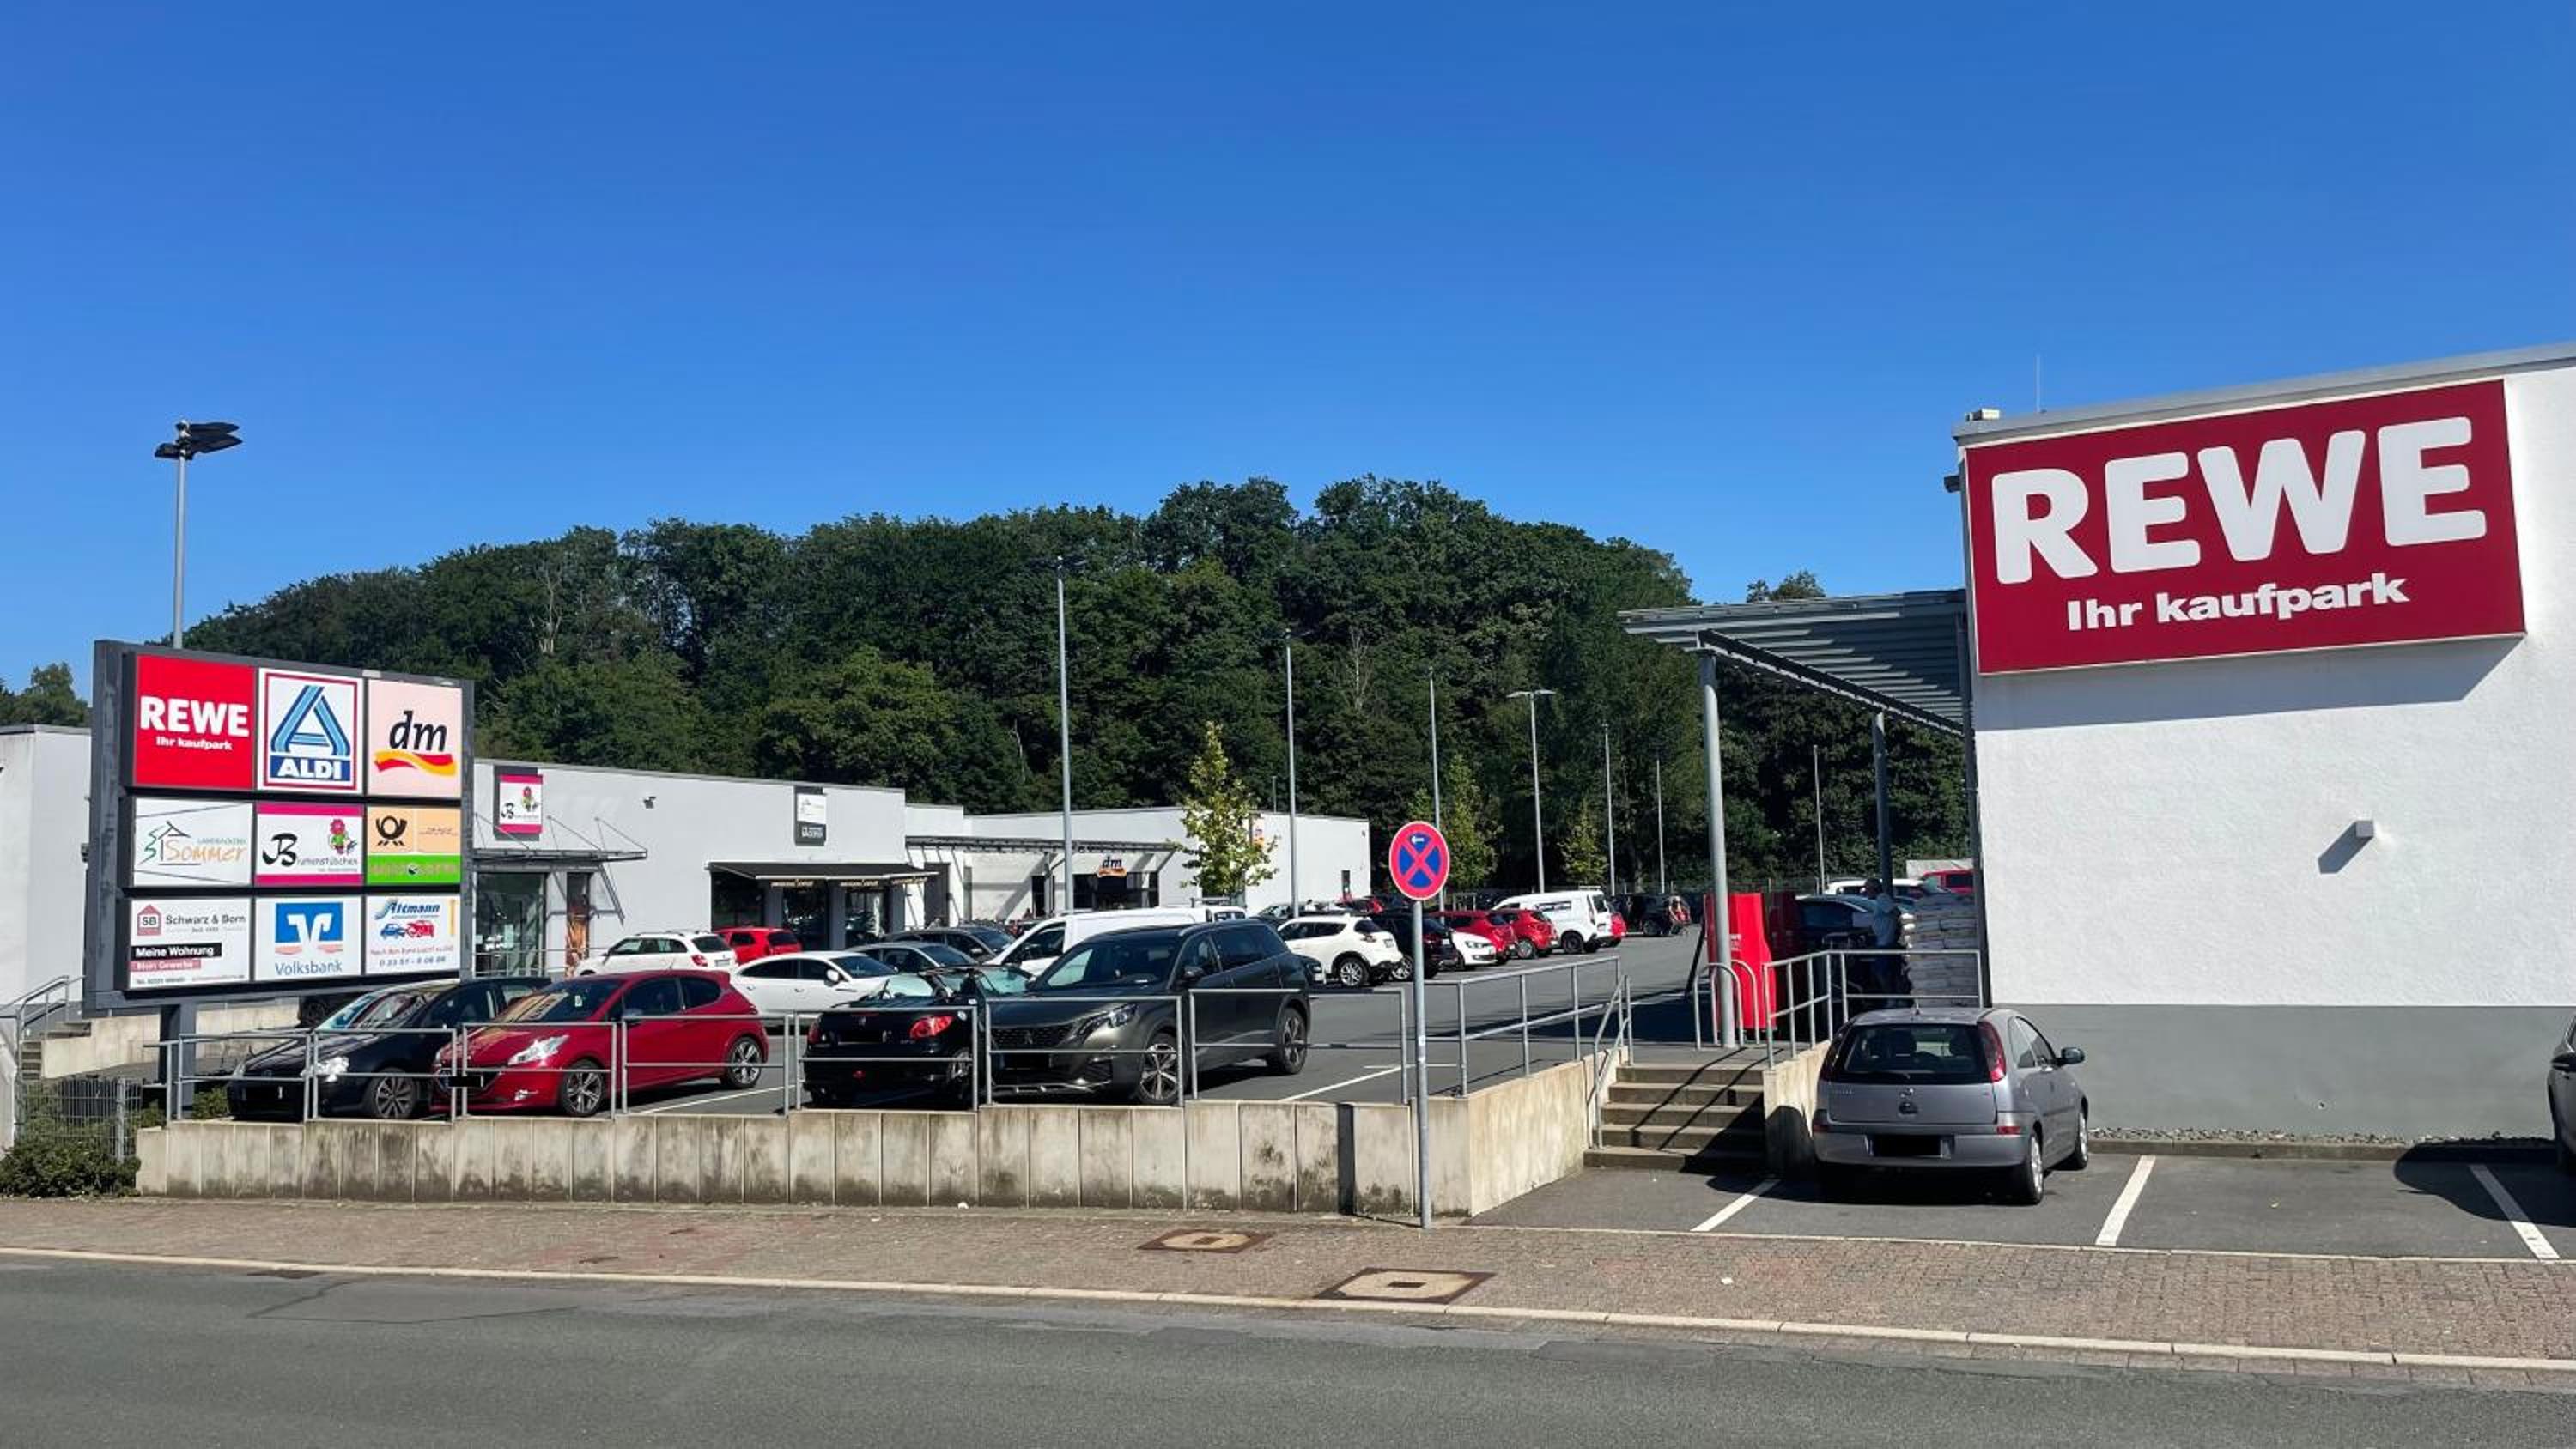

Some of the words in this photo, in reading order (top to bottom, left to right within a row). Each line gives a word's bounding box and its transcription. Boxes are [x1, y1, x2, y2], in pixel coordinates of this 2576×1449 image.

[1991, 417, 2487, 585] REWE
[2067, 598, 2142, 631] Ihr
[2155, 573, 2409, 621] kaufpark
[140, 695, 249, 737] REWE
[389, 710, 447, 752] dm
[156, 737, 175, 746] Ihr
[178, 737, 233, 751] kaufpark
[277, 757, 342, 780] ALDI
[1103, 856, 1122, 869] dm
[375, 899, 440, 920] Altmann
[142, 916, 157, 926] SB
[166, 914, 209, 925] Schwarz
[211, 914, 220, 925] &
[135, 947, 167, 958] Meine
[168, 946, 214, 957] Wohnung
[275, 960, 343, 976] Volksbank
